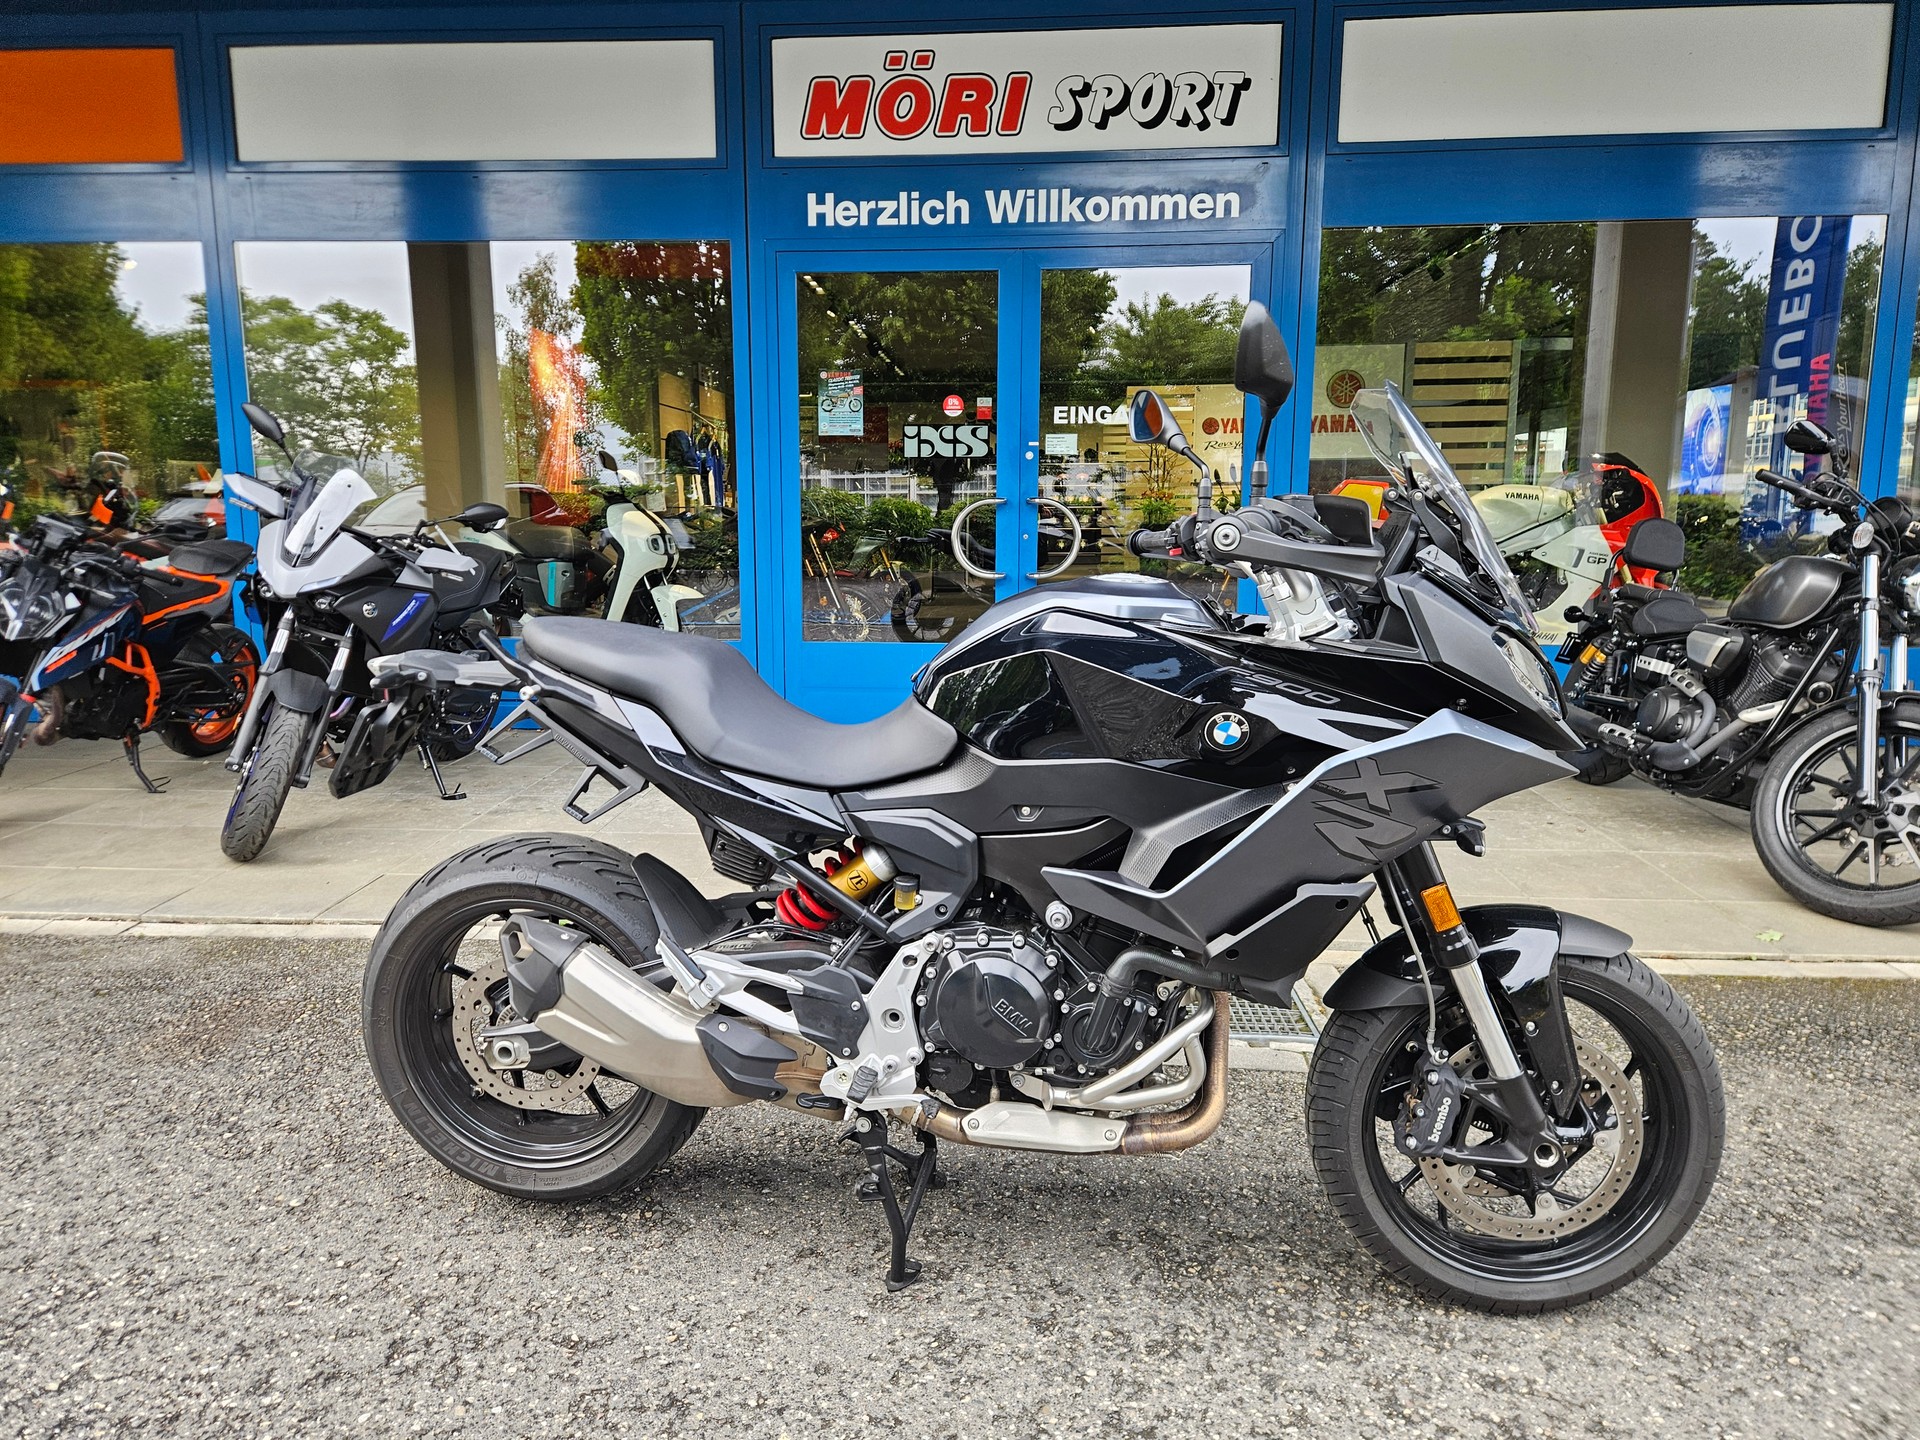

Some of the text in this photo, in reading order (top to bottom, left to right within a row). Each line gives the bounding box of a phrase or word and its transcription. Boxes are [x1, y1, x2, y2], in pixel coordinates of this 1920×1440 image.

[801, 49, 1252, 141] MÖRI SPORT
[807, 189, 1241, 227] Herzlich Willkommen
[1505, 491, 1540, 501] YAMAHA
[1587, 555, 1607, 565] GP
[1215, 713, 1249, 732] BMW
[994, 998, 1034, 1030] BMW
[1427, 1096, 1452, 1143] brembo
[403, 1100, 503, 1178] MICHELIN
